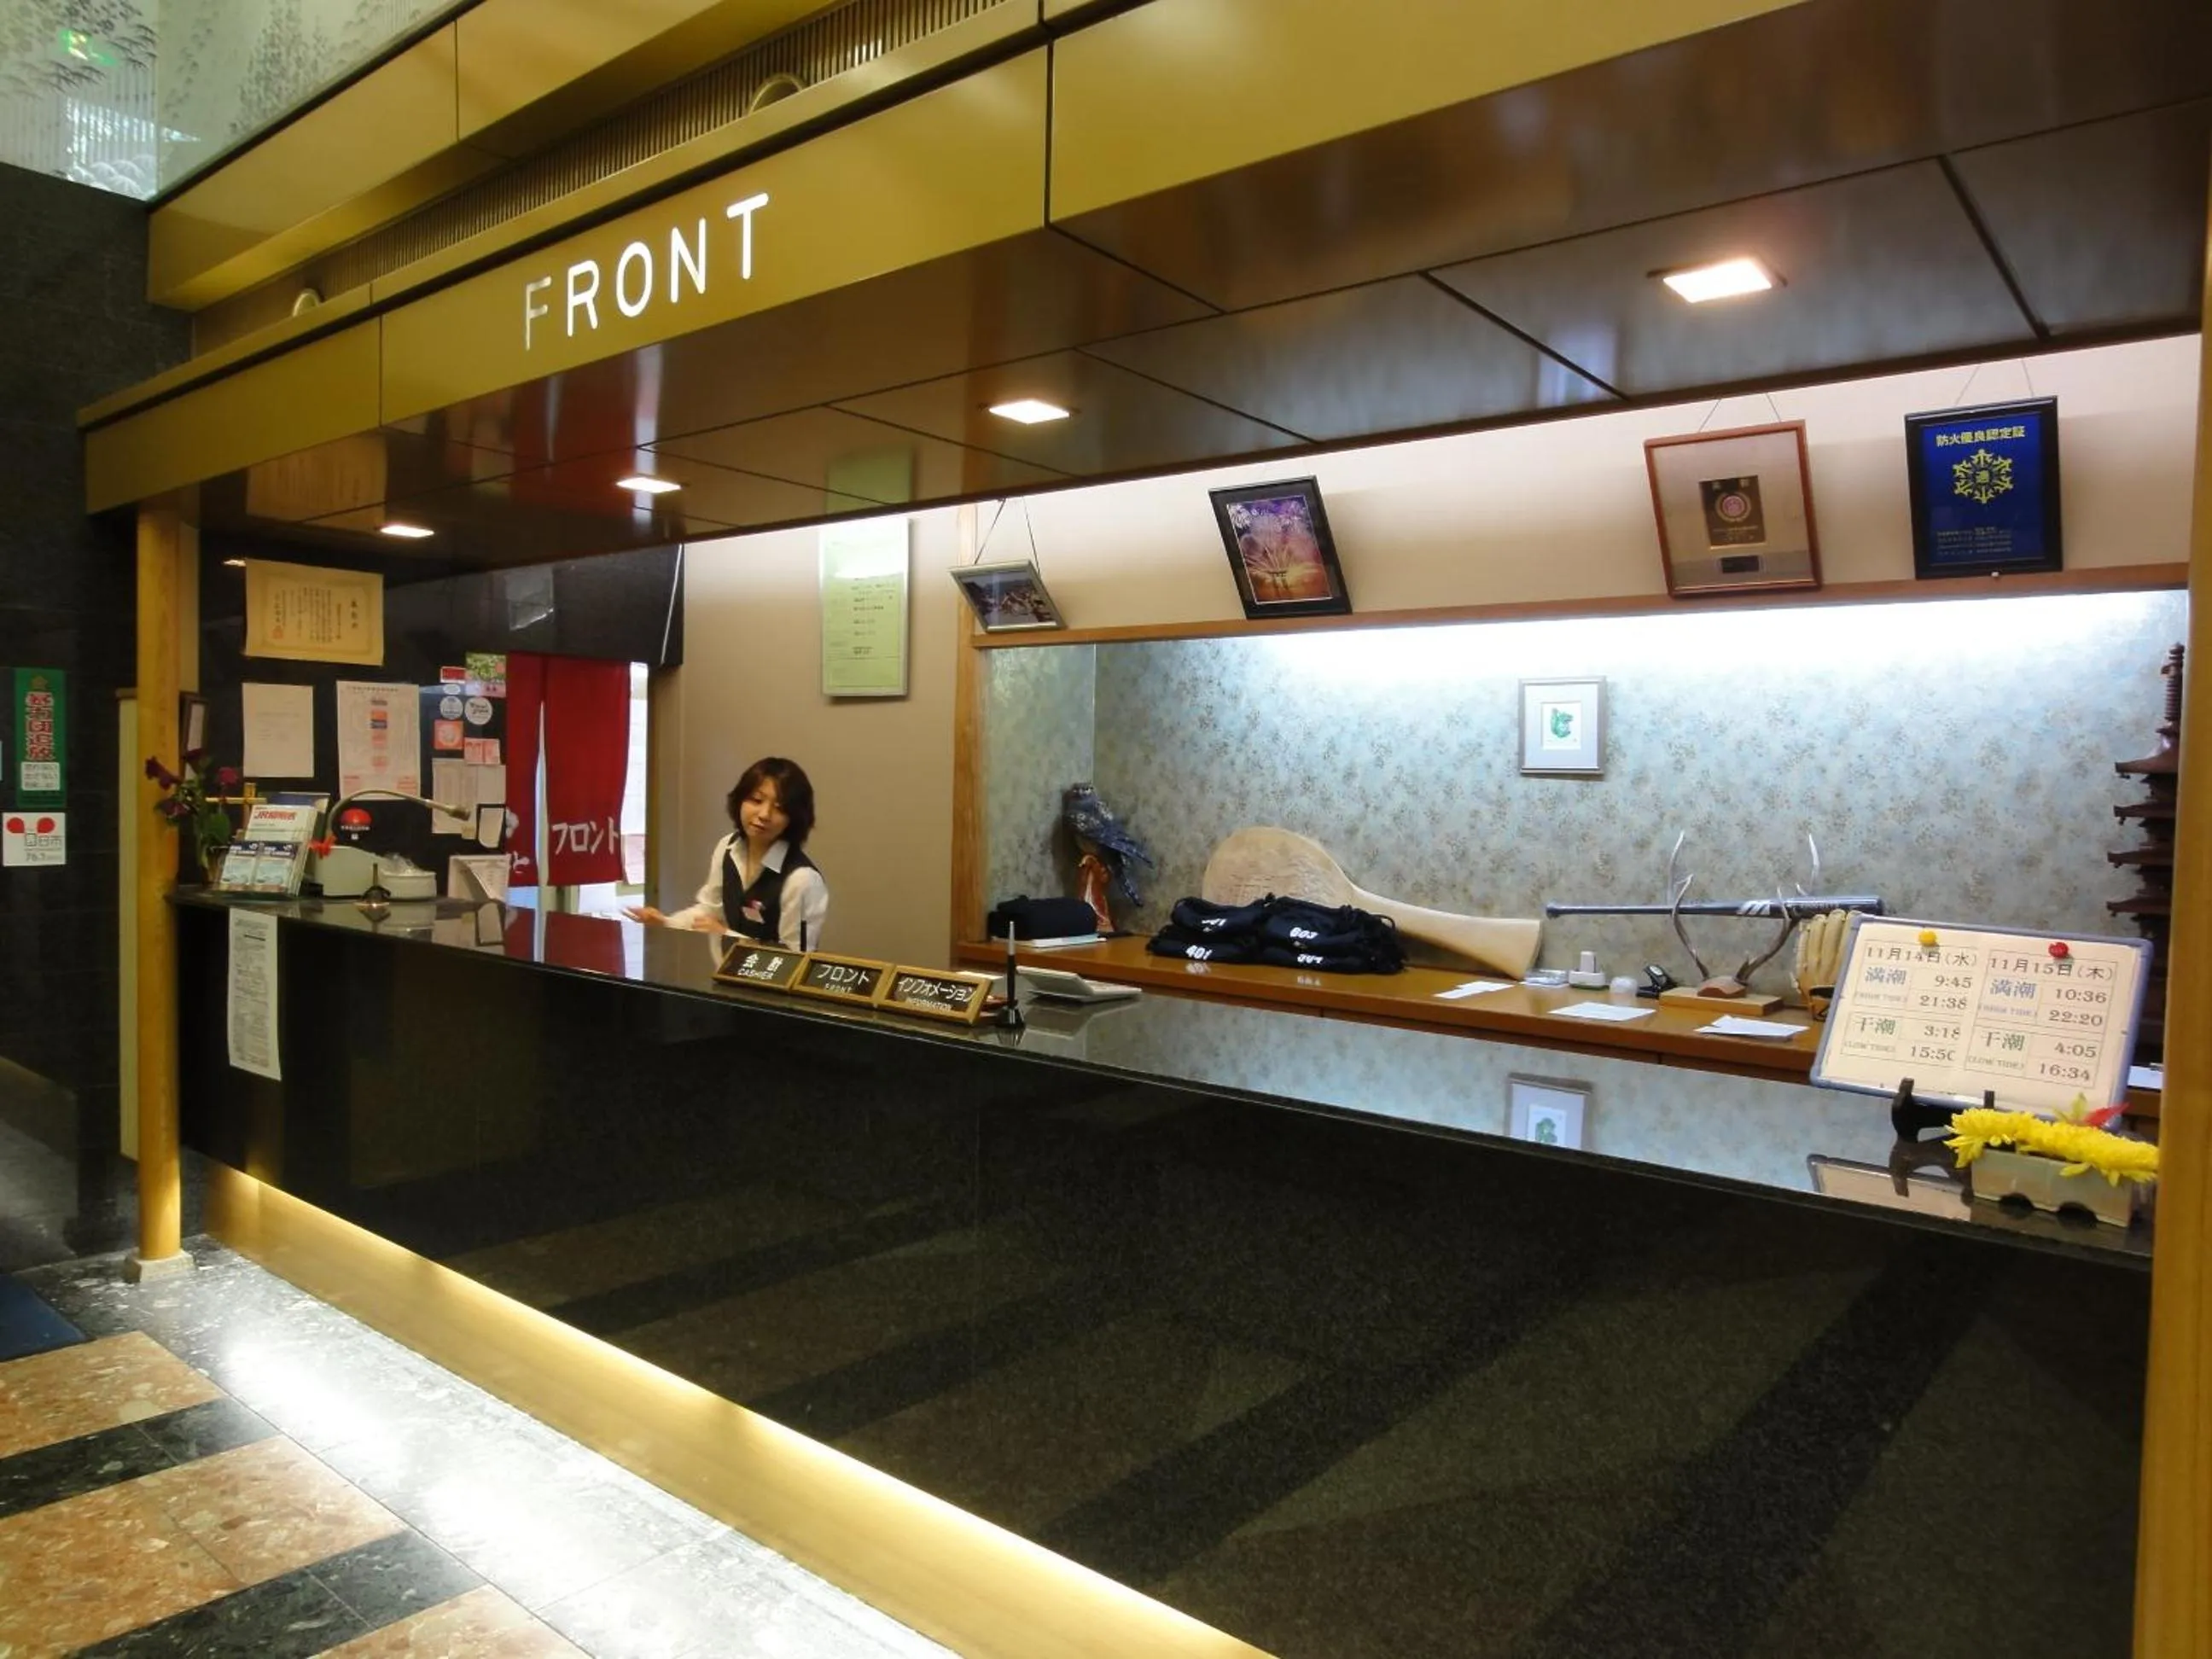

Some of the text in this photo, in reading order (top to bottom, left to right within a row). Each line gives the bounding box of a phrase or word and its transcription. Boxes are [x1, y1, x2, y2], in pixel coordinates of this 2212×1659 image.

[524, 192, 770, 351] FRONT
[1935, 425, 2026, 447] 防火優良認定証
[551, 817, 621, 854] フロント
[742, 953, 783, 973] 会計
[1185, 945, 1213, 961] 401
[737, 968, 773, 980] CASHIER
[817, 963, 870, 986] フロント
[1865, 966, 1907, 986] 満潮
[1989, 957, 2114, 981] 11月15日(木)
[898, 976, 976, 1003] インフォメーション
[1934, 975, 1973, 989] 9:45
[1989, 979, 2037, 999] 満潮
[1919, 995, 1967, 1010] 21:38
[2055, 988, 2107, 1004] 10:36
[2049, 1010, 2103, 1027] 22:20
[1924, 1025, 1961, 1040] 3:18
[1981, 1031, 2026, 1051] 干潮
[2054, 1041, 2098, 1059] 4:05
[2040, 1062, 2091, 1081] 16:34
